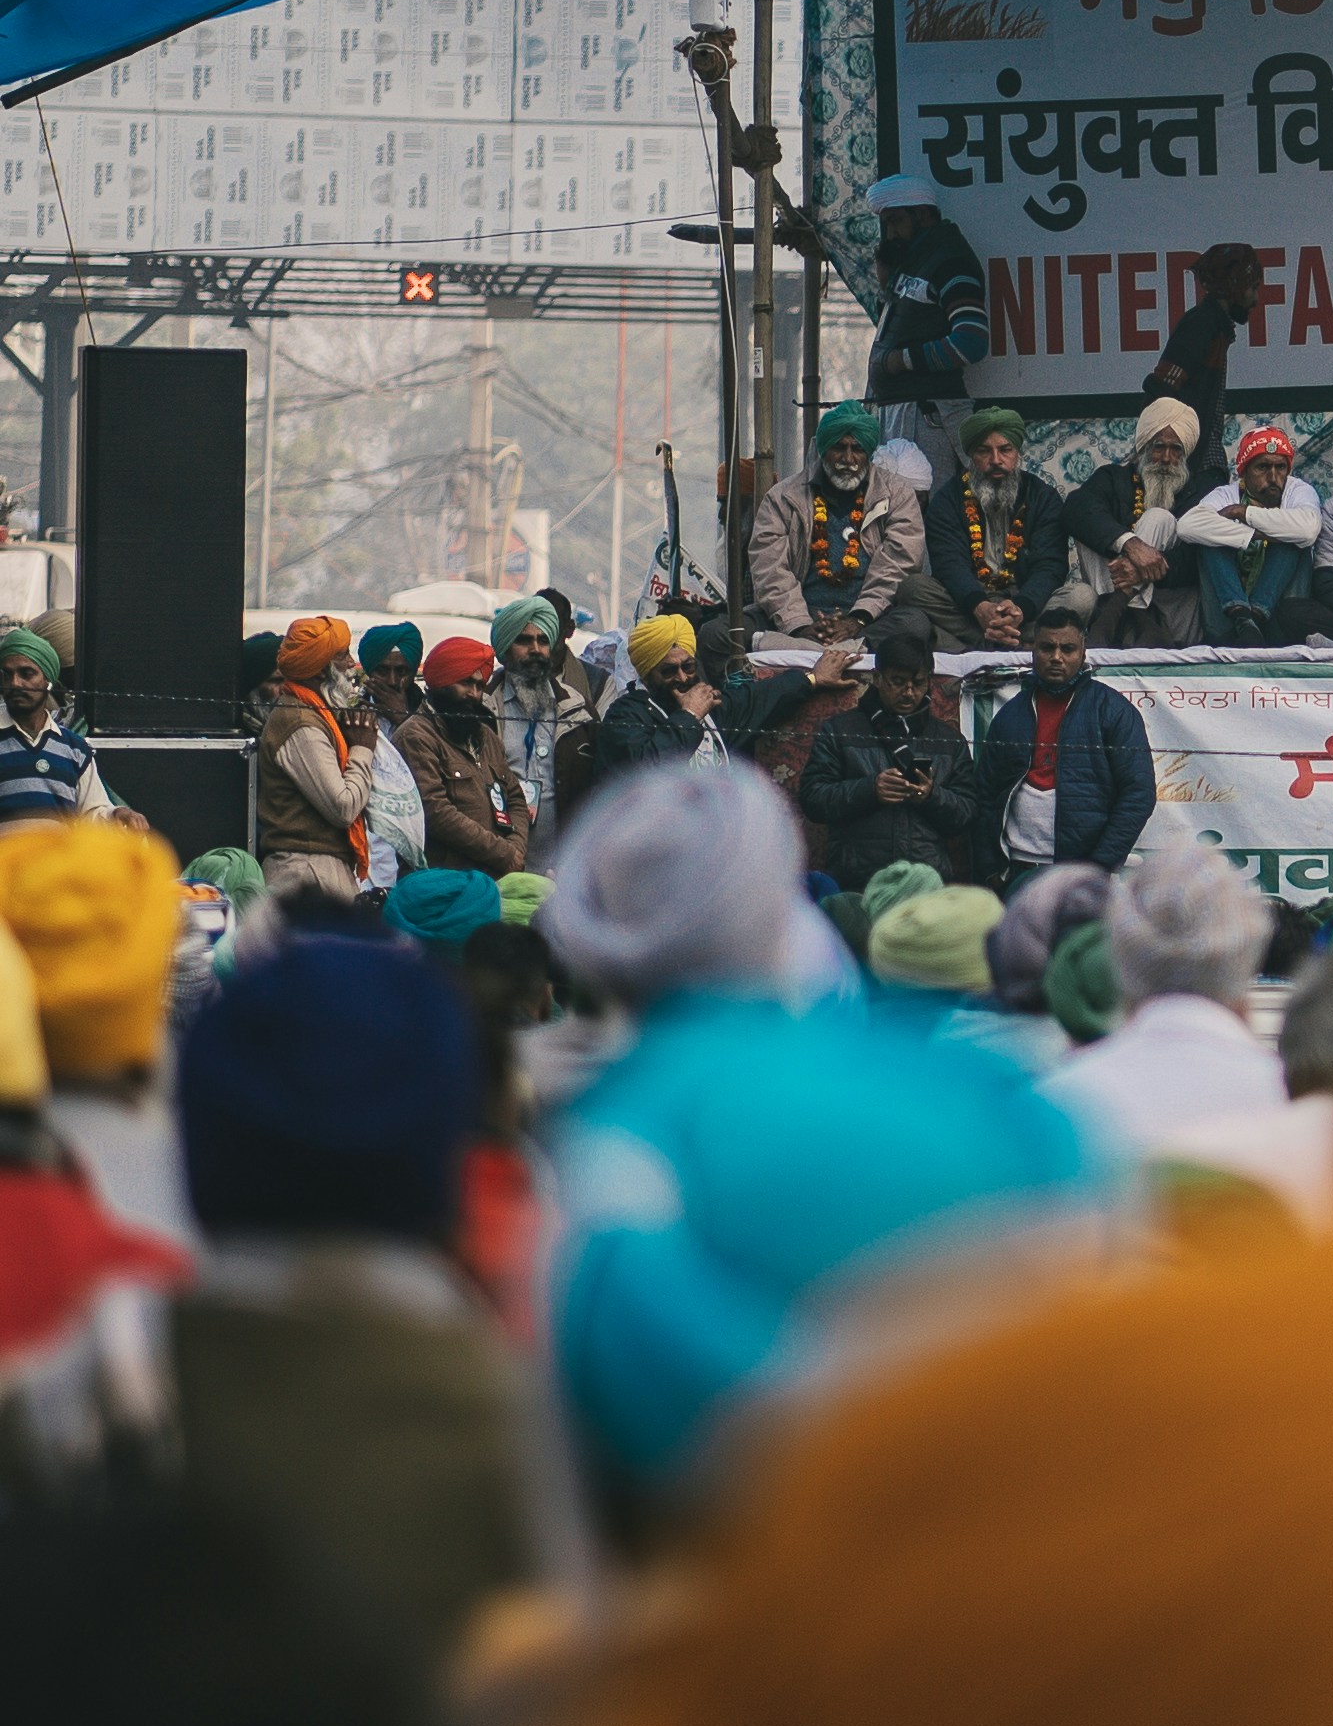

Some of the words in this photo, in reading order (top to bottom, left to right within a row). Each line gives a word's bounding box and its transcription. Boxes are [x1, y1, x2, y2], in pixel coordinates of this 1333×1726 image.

[918, 67, 1224, 232] संयुक्त
[987, 251, 1206, 357] NITED
[1166, 685, 1241, 709] ਏਕਤਾ
